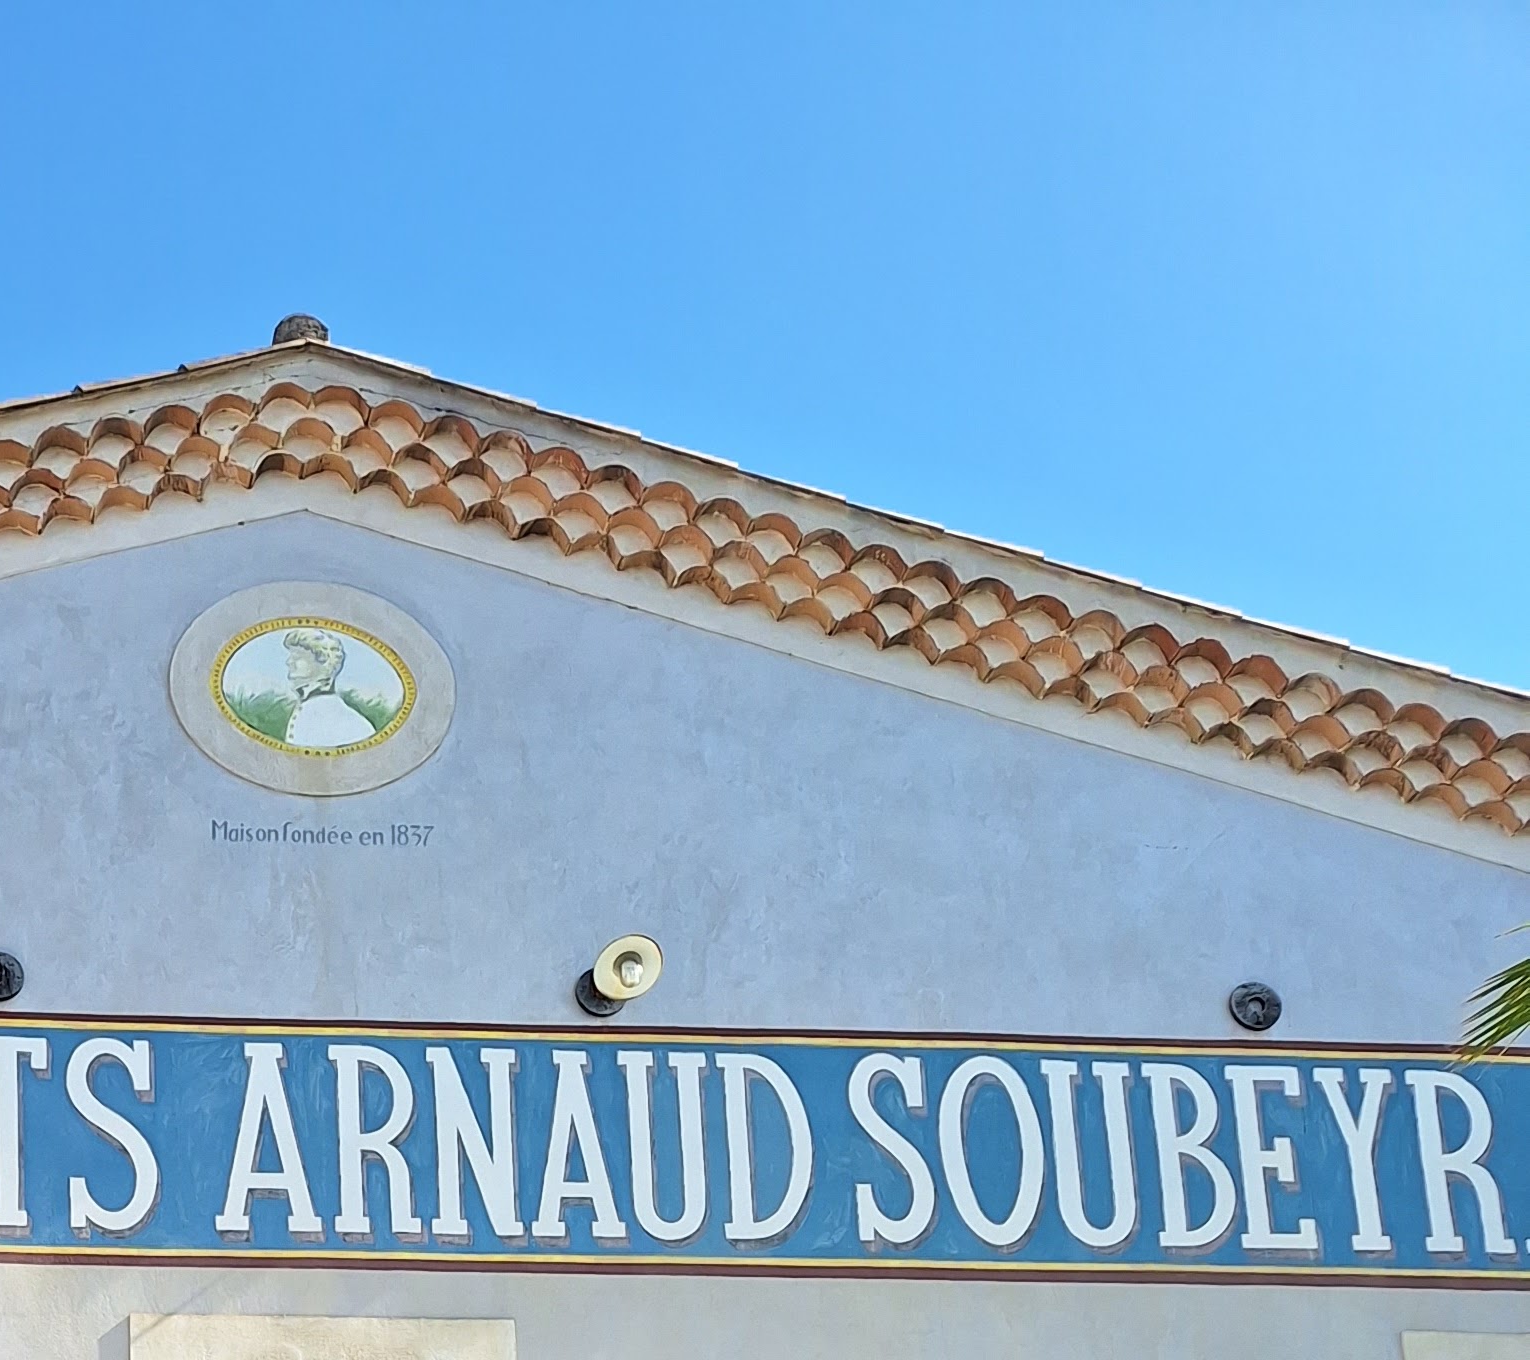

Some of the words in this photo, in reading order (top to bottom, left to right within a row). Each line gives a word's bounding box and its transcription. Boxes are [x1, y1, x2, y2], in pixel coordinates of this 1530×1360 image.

[211, 819, 279, 843] Maison
[282, 821, 353, 845] fondée
[359, 830, 384, 846] en
[391, 823, 435, 847] 1837
[215, 1042, 813, 1241] ARNAUD
[848, 1052, 1530, 1255] SOUBEYR
